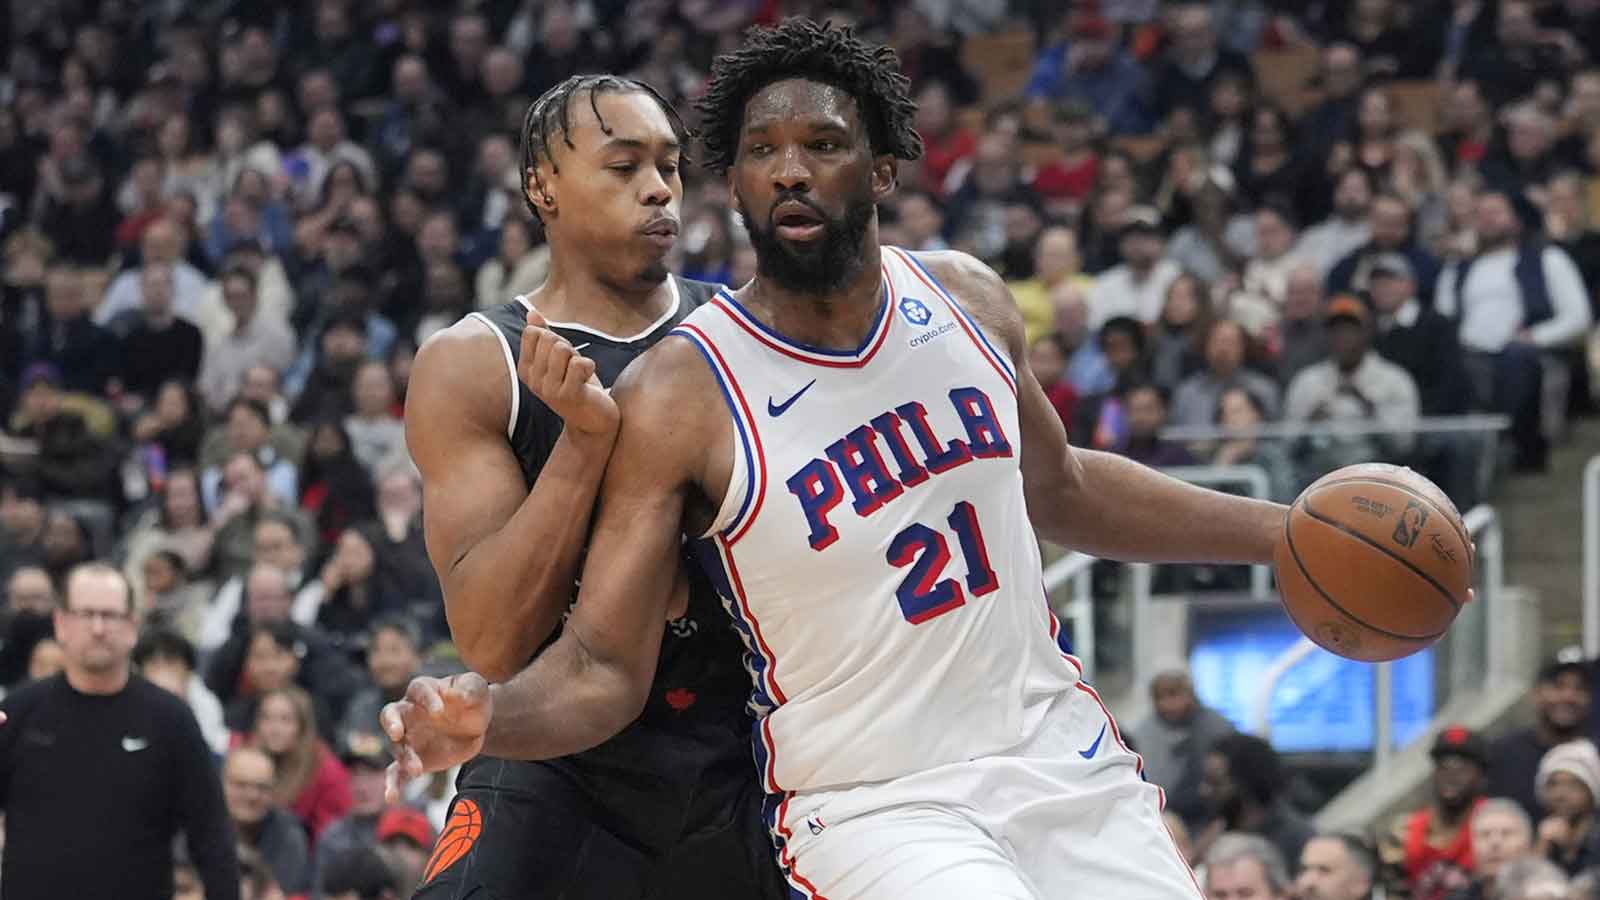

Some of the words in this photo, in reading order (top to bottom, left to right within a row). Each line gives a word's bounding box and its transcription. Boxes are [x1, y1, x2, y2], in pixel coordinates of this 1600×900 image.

[909, 321, 958, 347] crypto.com
[786, 386, 1013, 552] PHILA
[886, 500, 1000, 625] 21
